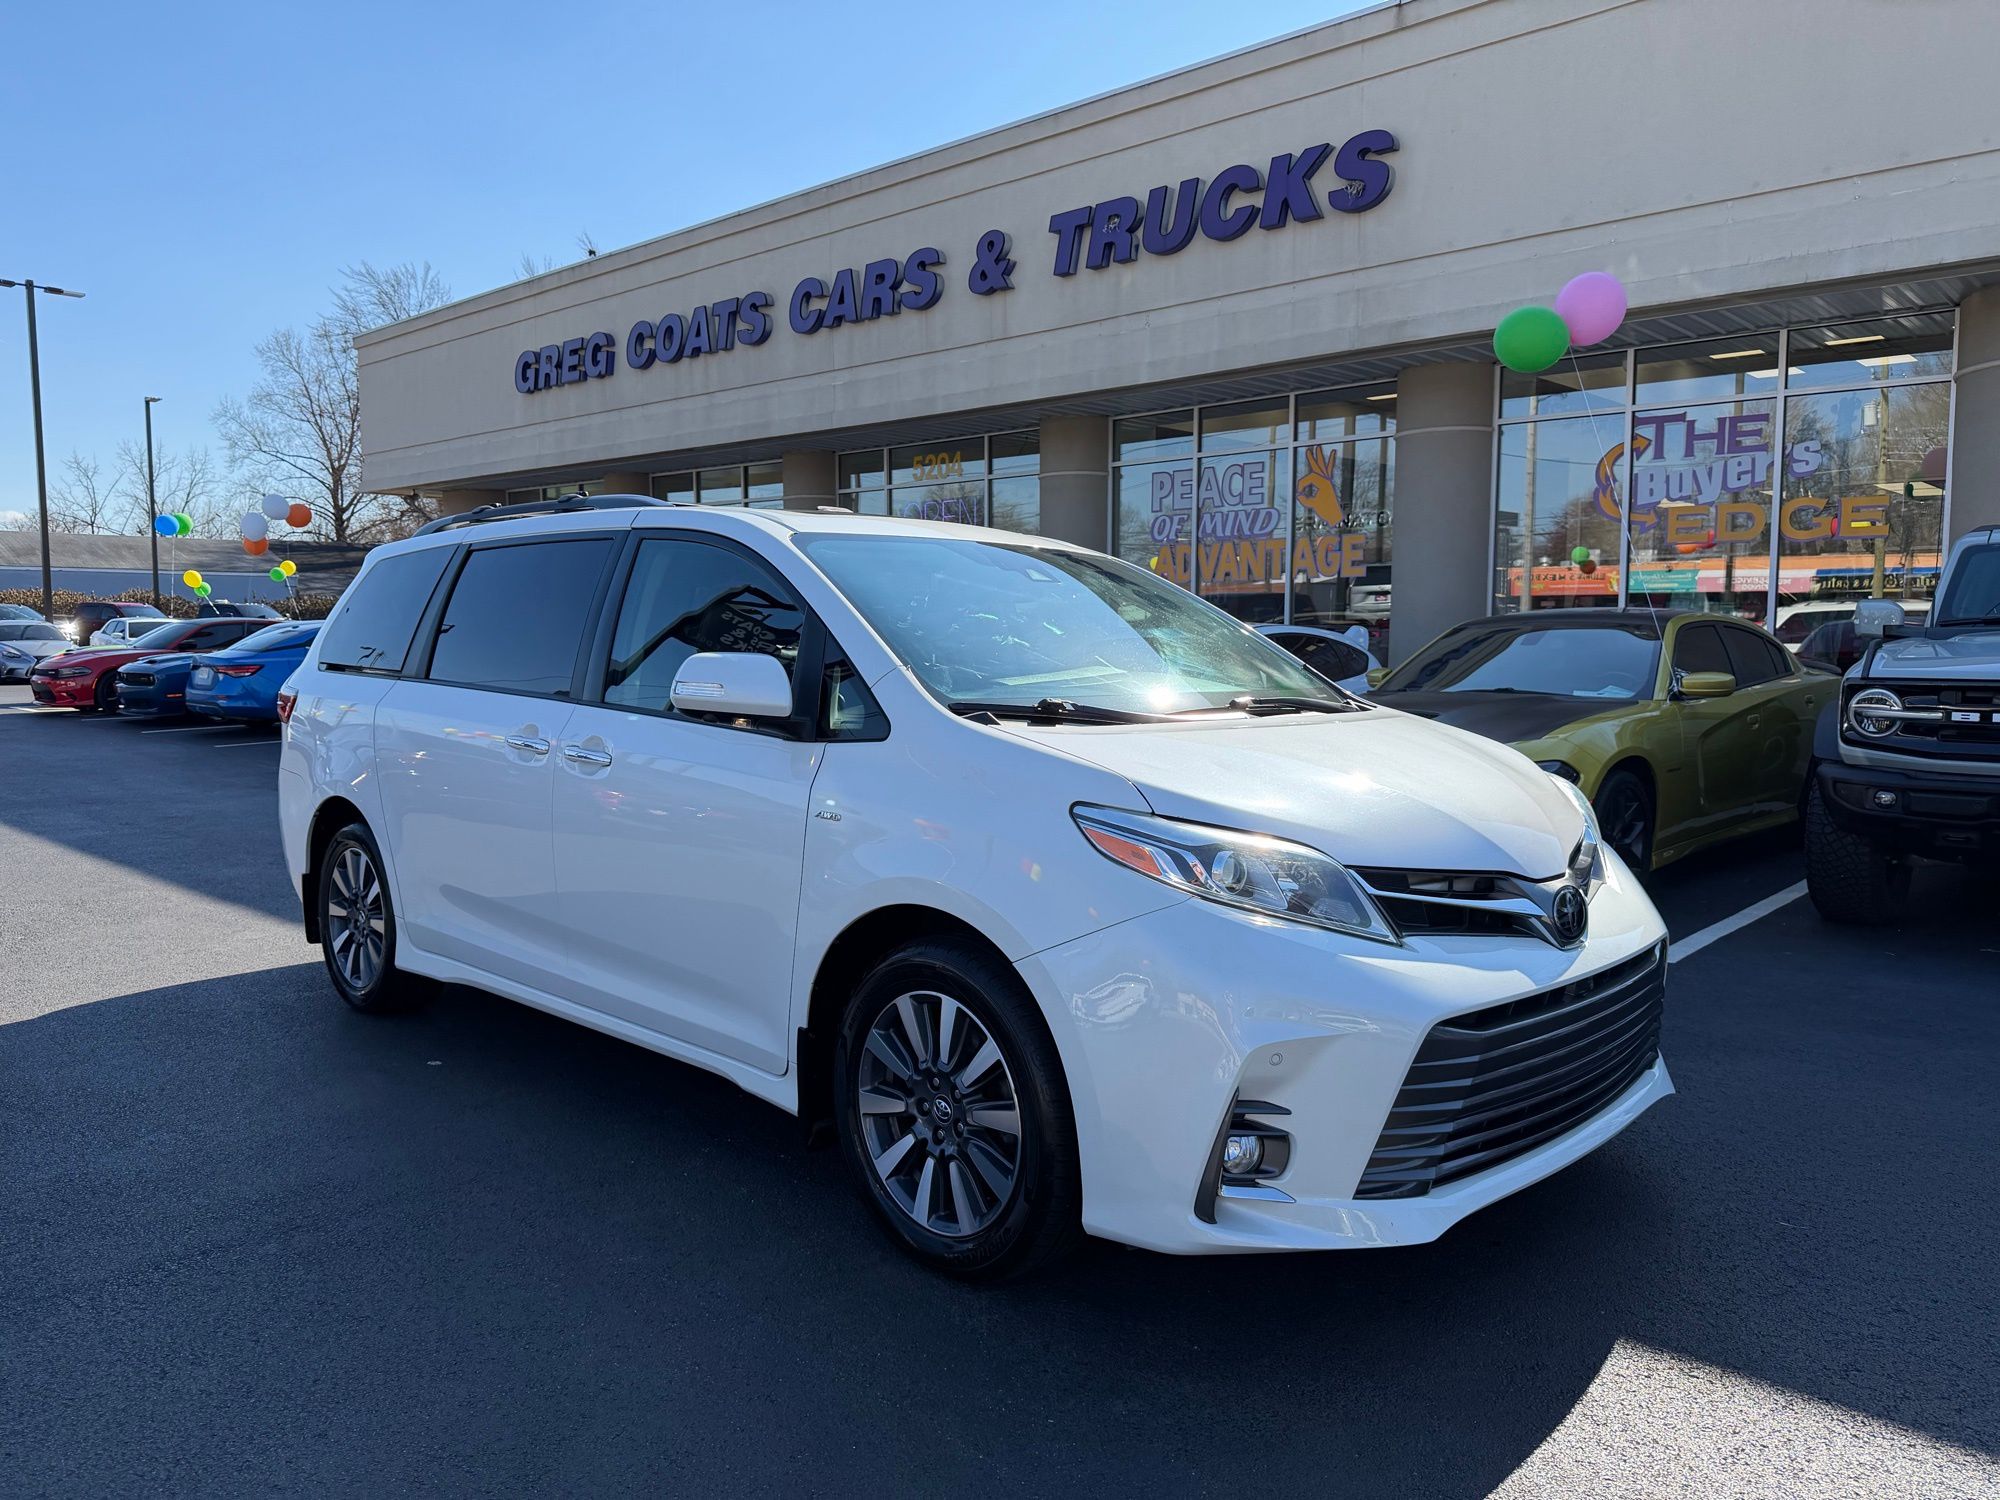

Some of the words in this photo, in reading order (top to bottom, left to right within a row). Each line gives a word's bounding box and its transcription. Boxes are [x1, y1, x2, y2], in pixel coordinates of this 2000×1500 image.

[514, 331, 615, 393] GREG
[626, 291, 773, 370] COATS
[789, 247, 946, 335] CARS
[968, 229, 1016, 297] &
[1048, 129, 1399, 278] TRUCKS
[1633, 411, 1770, 461] THE
[912, 451, 963, 481] 5204
[1151, 461, 1265, 512] PEACE
[1151, 513, 1190, 543] OF
[1197, 507, 1281, 539] MIND
[1663, 494, 1892, 547] EDGE
[1154, 534, 1367, 583] ADVANTAGE
